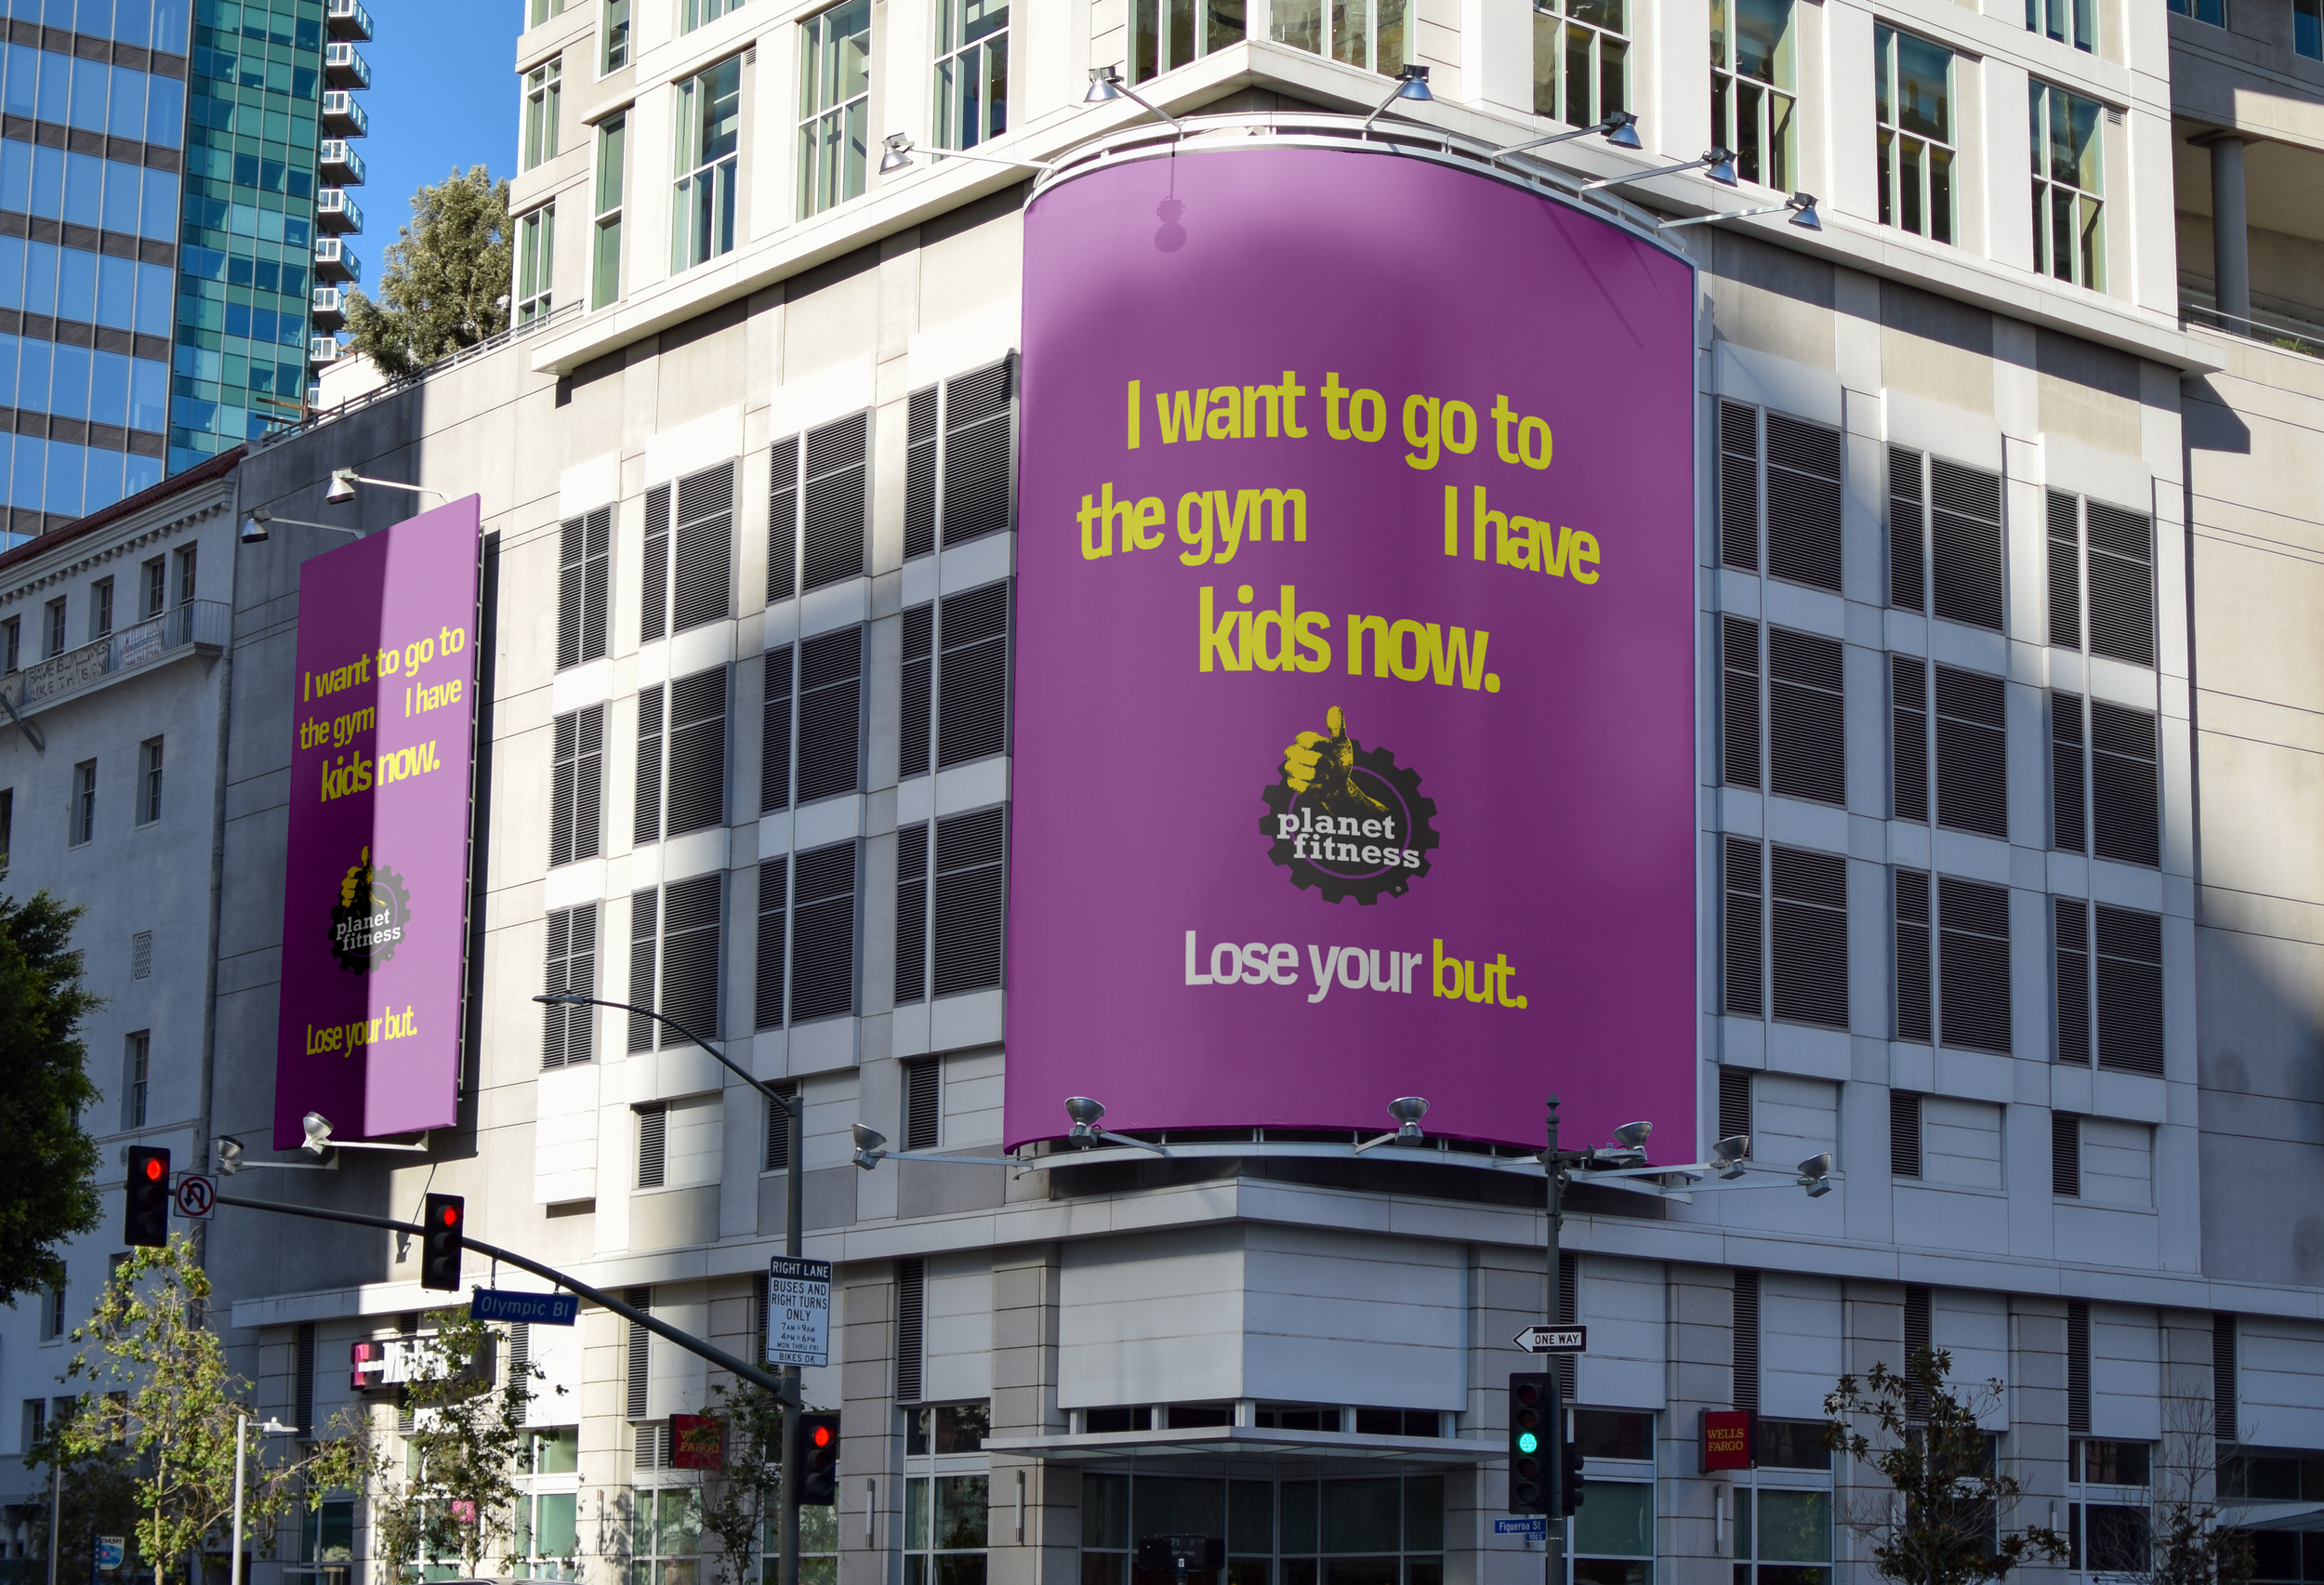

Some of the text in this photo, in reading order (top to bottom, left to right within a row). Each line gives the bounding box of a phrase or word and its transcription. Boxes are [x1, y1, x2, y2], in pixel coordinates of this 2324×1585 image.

[1128, 371, 1552, 470] I want to go to
[1076, 482, 1601, 585] the gym I have
[1199, 584, 1500, 693] kids now.
[304, 626, 465, 702] I want to go to
[300, 679, 462, 749] the gym I have
[321, 740, 441, 802] kids now.
[1276, 807, 1394, 839] planet
[1294, 834, 1420, 868] fitness
[336, 908, 390, 940] planet
[343, 926, 401, 951] fitness
[1185, 931, 1527, 1009] Lose your but.
[307, 1005, 417, 1058] Lose your but.
[772, 1261, 829, 1278] RIGHT LANE
[773, 1280, 826, 1296] BUSES AND
[481, 1296, 569, 1317] Olympic Bl
[772, 1294, 827, 1310] RIGHT TURNS
[786, 1309, 811, 1321] ONLY
[782, 1323, 796, 1331] 7AM
[801, 1325, 815, 1333] 9AM
[1535, 1334, 1578, 1344] ONE WAY
[779, 1354, 802, 1363] BIKES
[1707, 1429, 1744, 1439] WELLS
[1709, 1441, 1744, 1451] FARGO
[1499, 1521, 1540, 1533] Figueroa St
